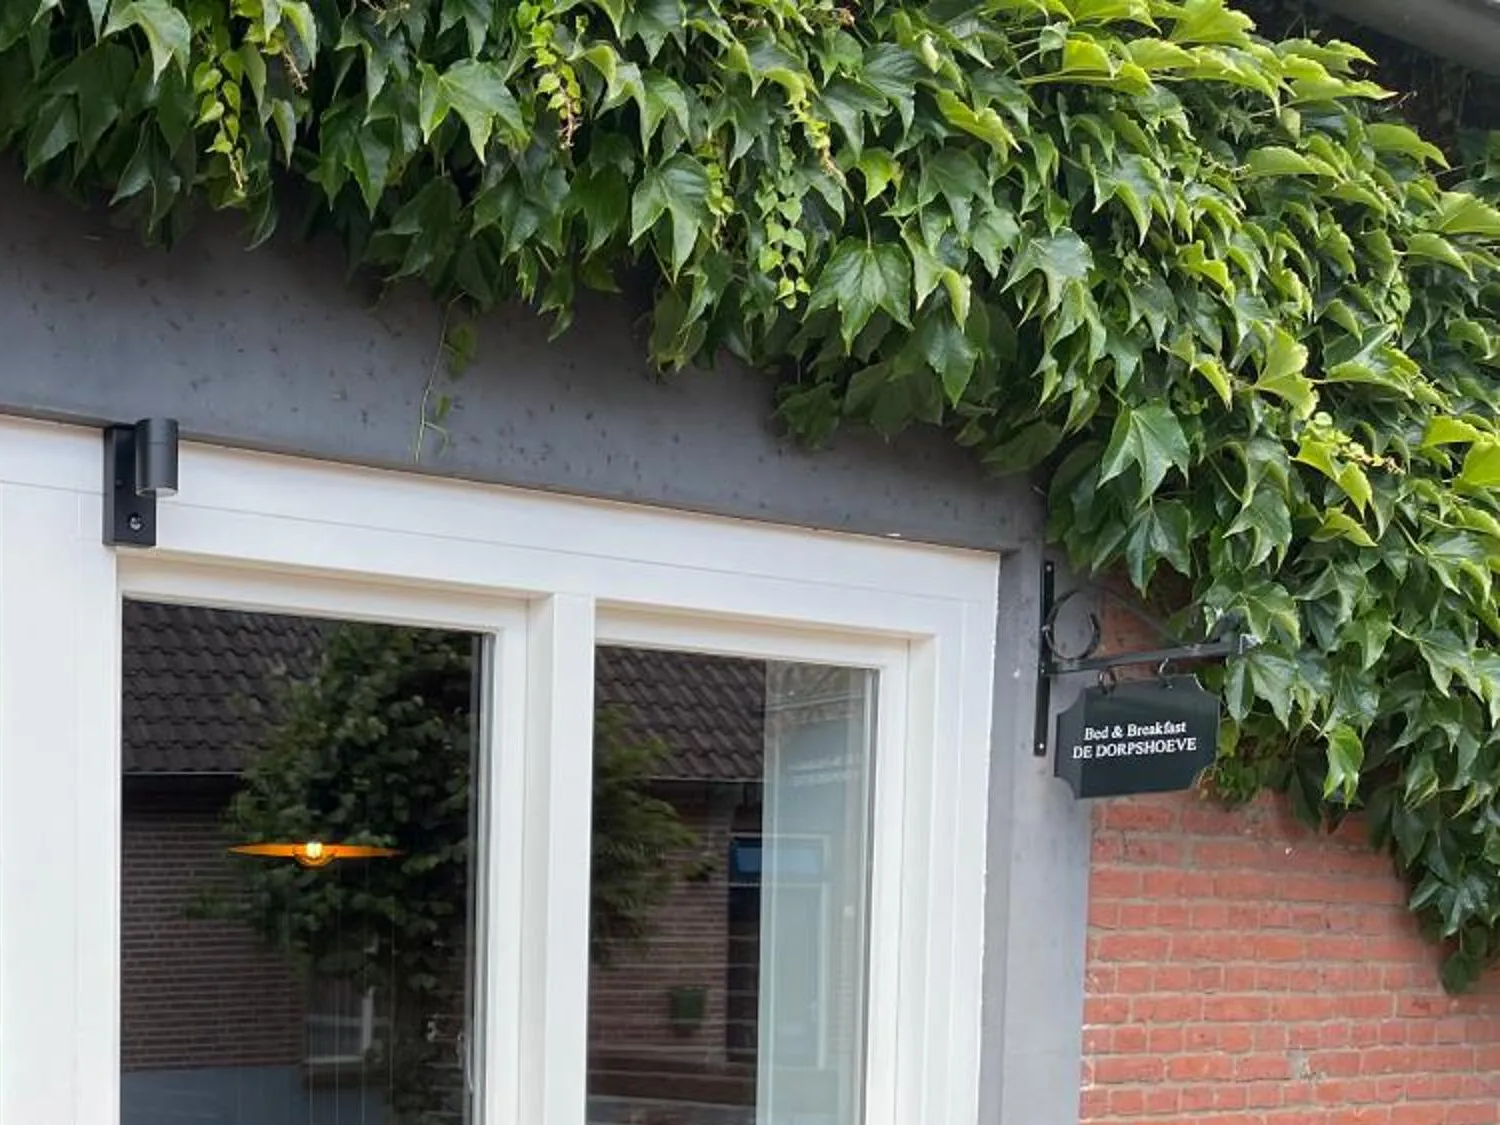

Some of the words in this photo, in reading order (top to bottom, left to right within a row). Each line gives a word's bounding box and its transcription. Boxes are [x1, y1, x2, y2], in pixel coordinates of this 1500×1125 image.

[1084, 727, 1109, 741] Bed
[1111, 726, 1124, 739] &
[1127, 721, 1187, 736] Breakfast
[1073, 746, 1093, 759] DE
[1096, 737, 1197, 757] DORPSHOEVE
